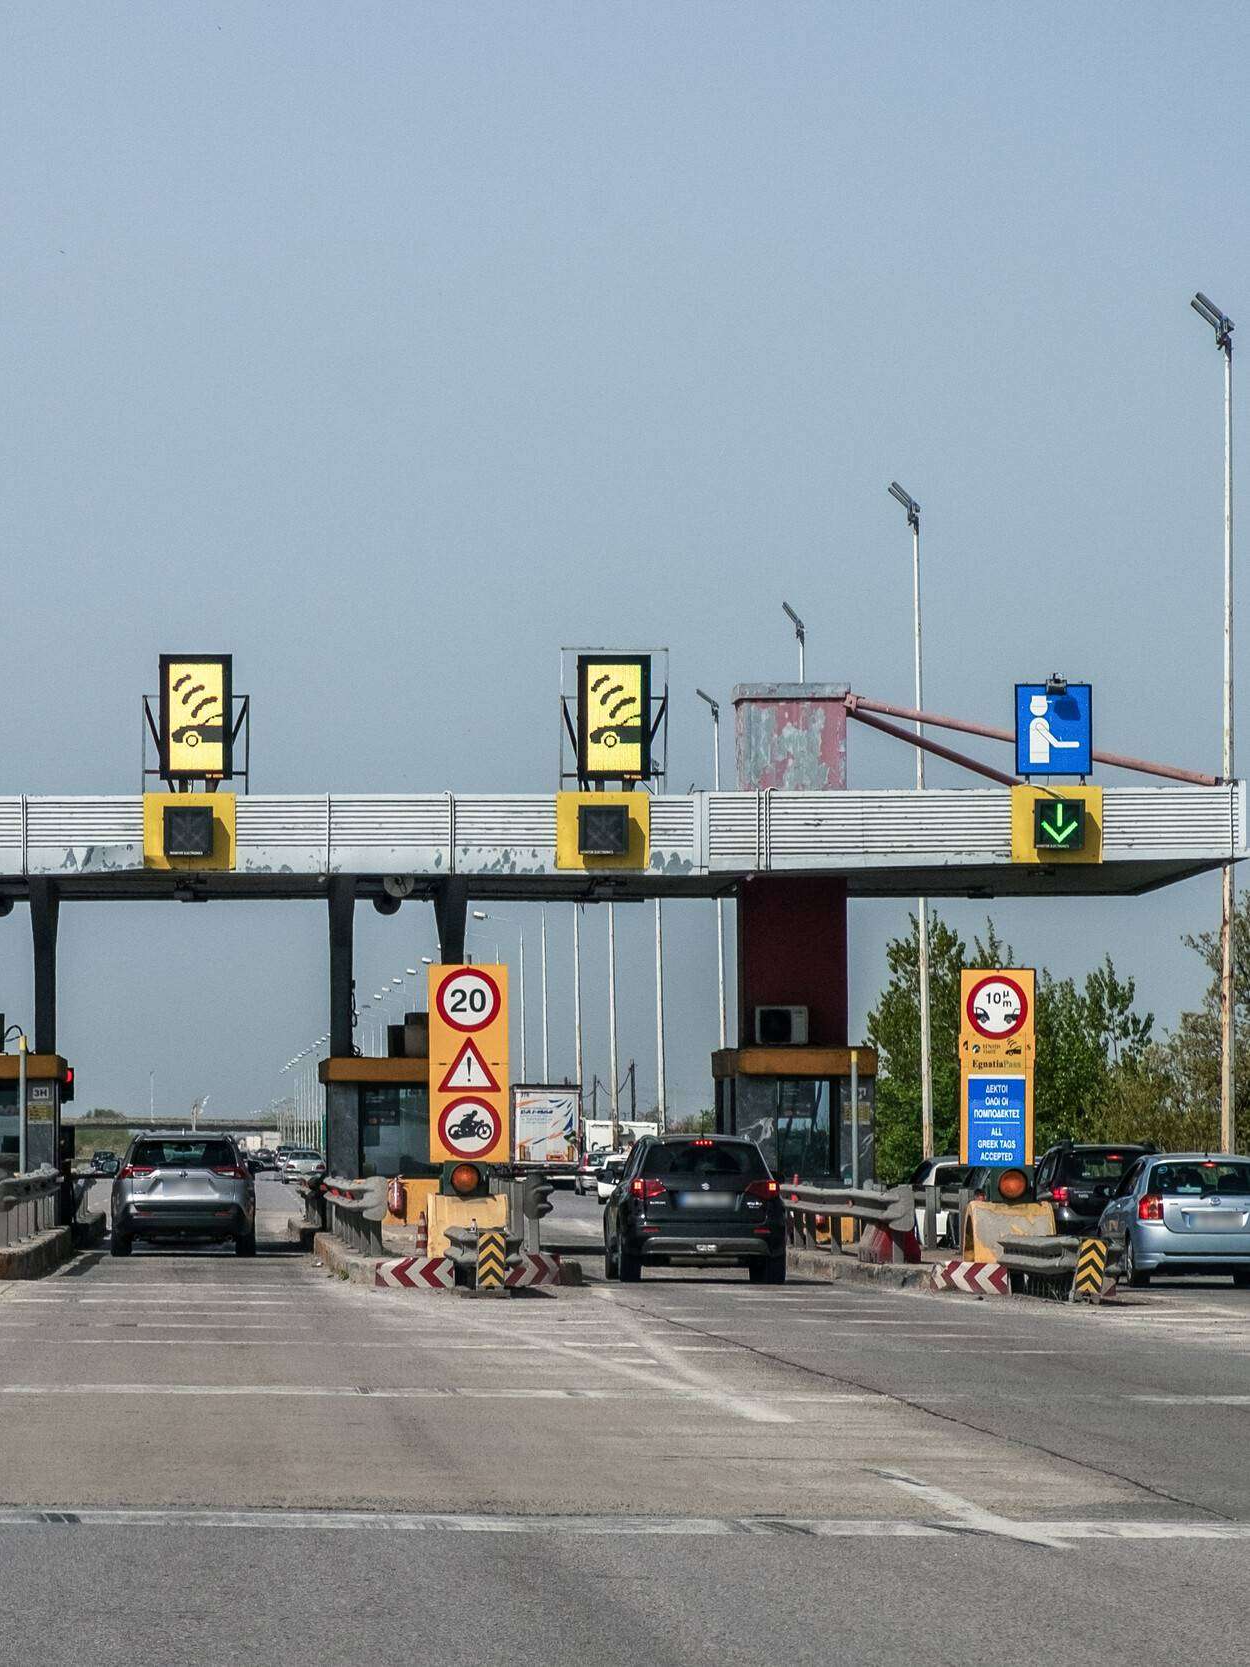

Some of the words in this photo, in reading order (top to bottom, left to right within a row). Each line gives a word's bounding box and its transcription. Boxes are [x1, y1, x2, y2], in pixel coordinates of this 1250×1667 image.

[450, 988, 487, 1013] 20
[986, 992, 1001, 1005] 10
[991, 1127, 1003, 1137] ALL
[977, 1139, 999, 1149] GREEK
[1000, 1139, 1017, 1149] TAGS
[980, 1152, 1014, 1162] ACCEPTED
